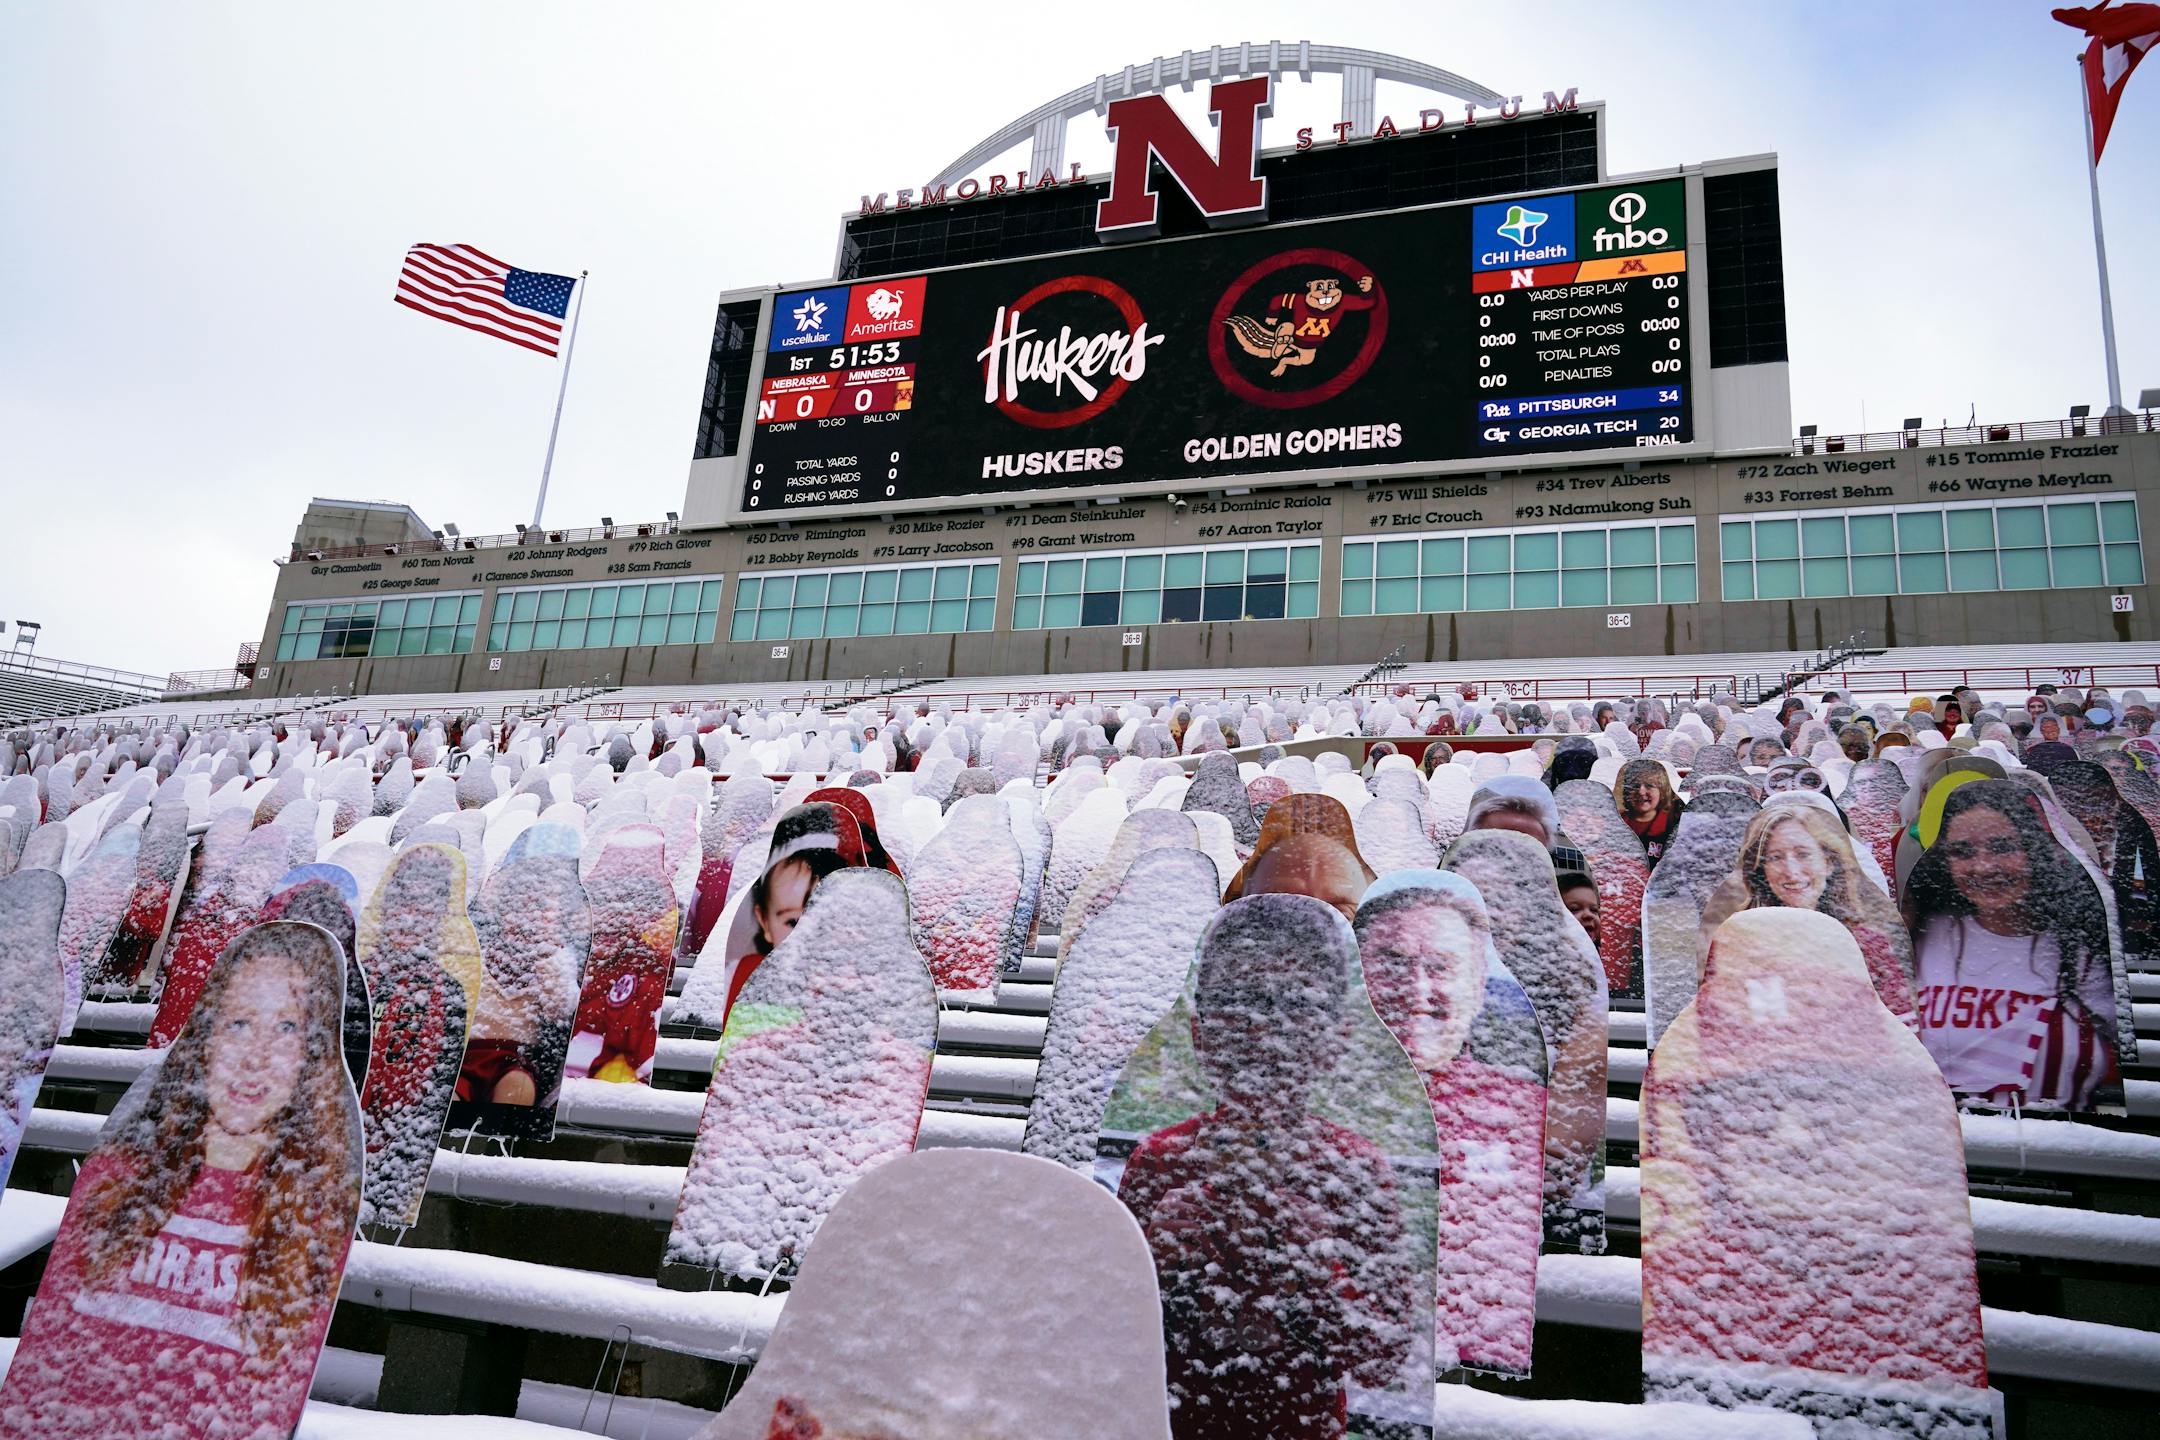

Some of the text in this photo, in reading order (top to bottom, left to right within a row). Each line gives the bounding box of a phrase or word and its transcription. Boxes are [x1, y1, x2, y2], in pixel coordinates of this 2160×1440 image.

[1296, 87, 1579, 152] STADIUM
[1096, 74, 1274, 232] N
[859, 162, 1088, 217] MEMORIAL
[1593, 225, 1668, 252] fnbo
[1482, 245, 1567, 265] CHI Health
[1510, 269, 1533, 288] N
[1480, 276, 1678, 308] 0.0 YARDS PER PLAY 0.0
[1480, 296, 1679, 327] 0 FIRST DOWNS 0
[851, 319, 914, 336] Ameritas
[1480, 317, 1680, 347] 00:00 TIME OF POSS 00:00
[782, 333, 830, 346] uscellular
[790, 342, 900, 371] 1ST 51:53
[977, 306, 1165, 404] Huskers
[1480, 338, 1680, 368] 0 TOTAL PLAYS 0
[772, 376, 827, 389] NEBRASKA
[849, 366, 906, 381] MINNESOTA
[1480, 359, 1681, 388] 0/0 PENALTIES 0/0
[758, 400, 776, 420] N
[796, 395, 813, 417] 0
[854, 389, 872, 412] 0
[1519, 395, 1617, 414] PITTSBURGH
[1659, 390, 1678, 402] 34
[769, 423, 797, 432] DOWN
[818, 418, 846, 428] TO GO
[863, 413, 900, 424] BALL ON
[1519, 423, 1591, 440] GEORGIA
[1594, 419, 1637, 433] TECH
[1660, 417, 1680, 429] 20
[1183, 423, 1402, 464] GOLDEN GOPHERS
[1636, 434, 1680, 447] FINAL
[755, 452, 899, 474] 0 TOTAL YARDS 0
[981, 445, 1124, 479] HUSKERS
[1926, 442, 2119, 468] #15 Tommie Frazier
[1737, 457, 1896, 480] #72 Zach Wiegert
[753, 468, 897, 490] 0 PASSING YARDS 0
[1536, 472, 1671, 493] #34 Trev Alberts
[1928, 472, 2113, 494] #66 Wayne Meylan
[750, 486, 895, 507] 0 RUSHING YARDS 0
[1367, 484, 1488, 503] #75 Will Shields
[1744, 484, 1894, 504] #33 Forrest Behm
[1192, 495, 1331, 515] #54 Dominic Raiola
[1515, 496, 1692, 519] #93 Ndamukong Suh
[888, 519, 985, 535] #30 Mike Rozier
[1006, 507, 1146, 528] #71 Dean Steinkuhler
[1370, 509, 1483, 528] #7 Eric Crouch
[747, 528, 866, 544] #50 Dave Rimington
[1198, 520, 1323, 538] #67 Aaron Taylor
[629, 538, 712, 553] #79 Rich Glover
[873, 540, 993, 557] #75 Larry Jacobson
[1011, 531, 1135, 550] #98 Grant Wistrom
[402, 560, 418, 568] #60
[442, 555, 475, 566] Novak
[507, 546, 608, 561] #20 Johnny Rodgers
[747, 549, 859, 565] #12 Bobby Reynolds
[312, 562, 382, 576] Guy Chamberlin
[472, 568, 573, 582] #1 Clarence Swanson
[607, 560, 692, 574] #38 Sam Francis
[362, 577, 440, 590] #25 George Sauer
[2115, 597, 2129, 610] 37
[1609, 615, 1630, 626] 36-C
[1124, 634, 1141, 644] 36-B
[773, 648, 787, 657] 36-A
[490, 659, 500, 669] 35
[2062, 669, 2081, 685] 37
[1504, 682, 1530, 696] 36-C
[600, 705, 618, 716] 36-A
